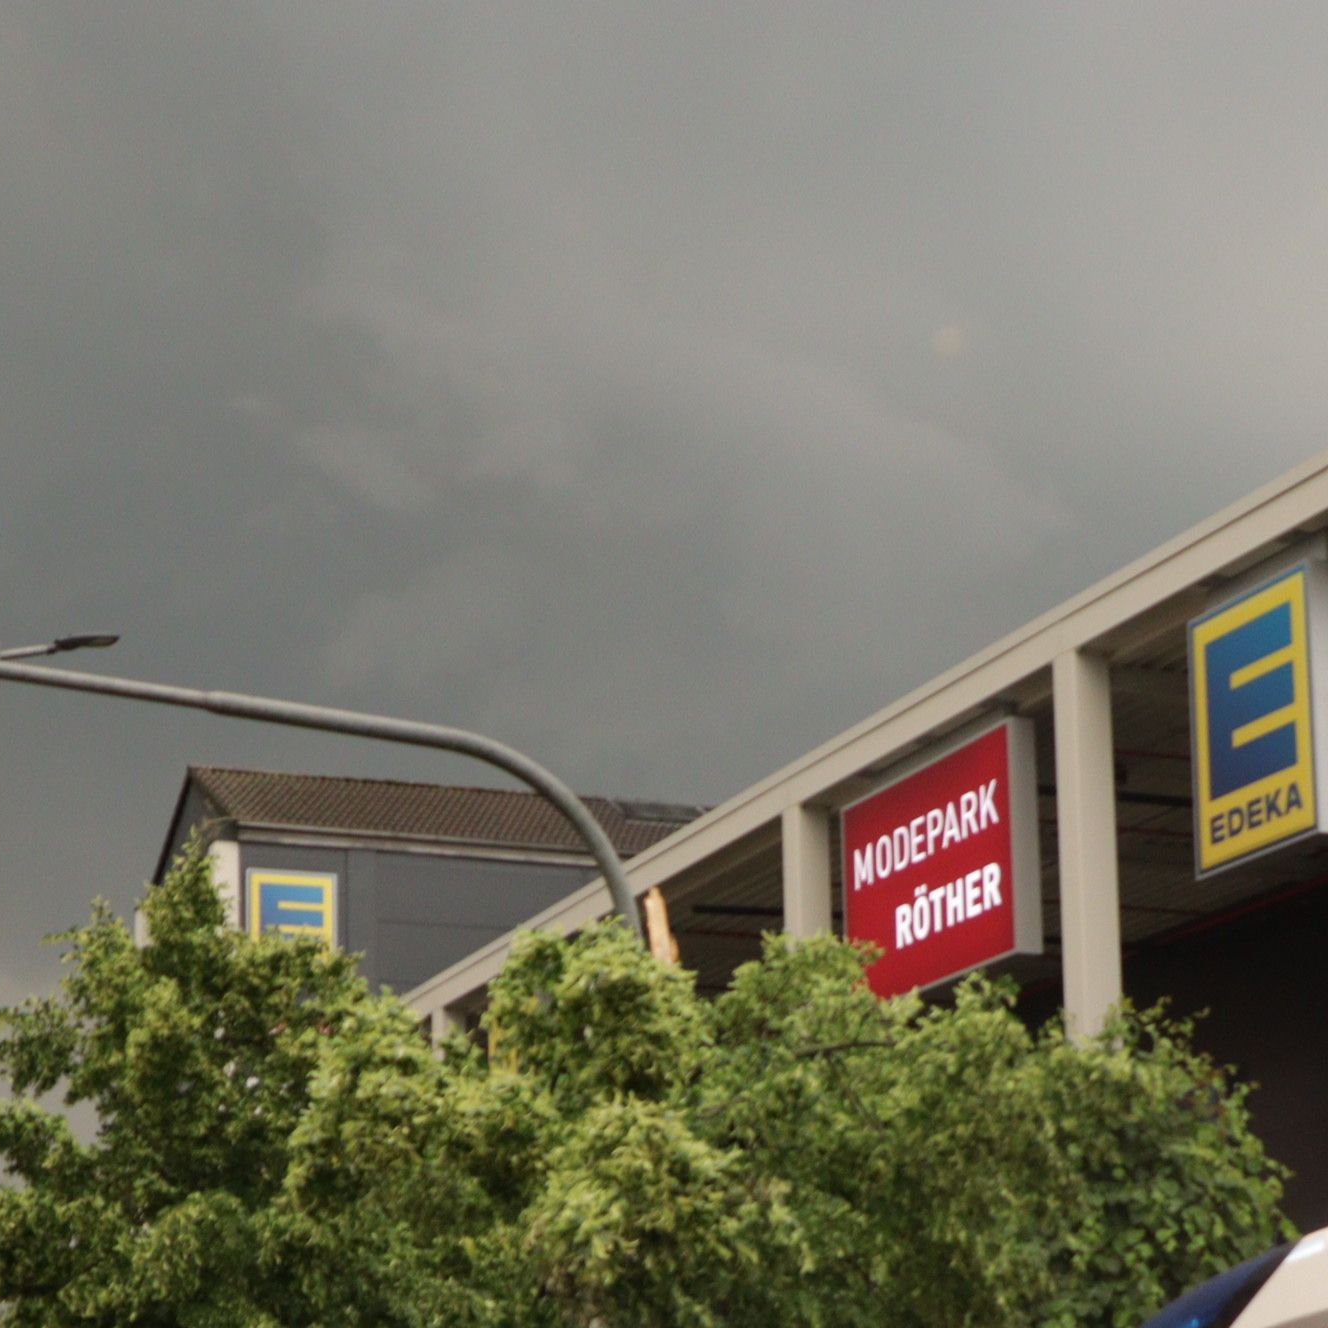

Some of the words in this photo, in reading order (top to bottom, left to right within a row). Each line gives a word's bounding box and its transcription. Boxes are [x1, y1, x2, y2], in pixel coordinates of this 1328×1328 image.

[1203, 599, 1299, 801] E
[853, 778, 1000, 892] MODEPARK
[1209, 782, 1304, 845] EDEKA
[895, 862, 1003, 949] RÖTHER
